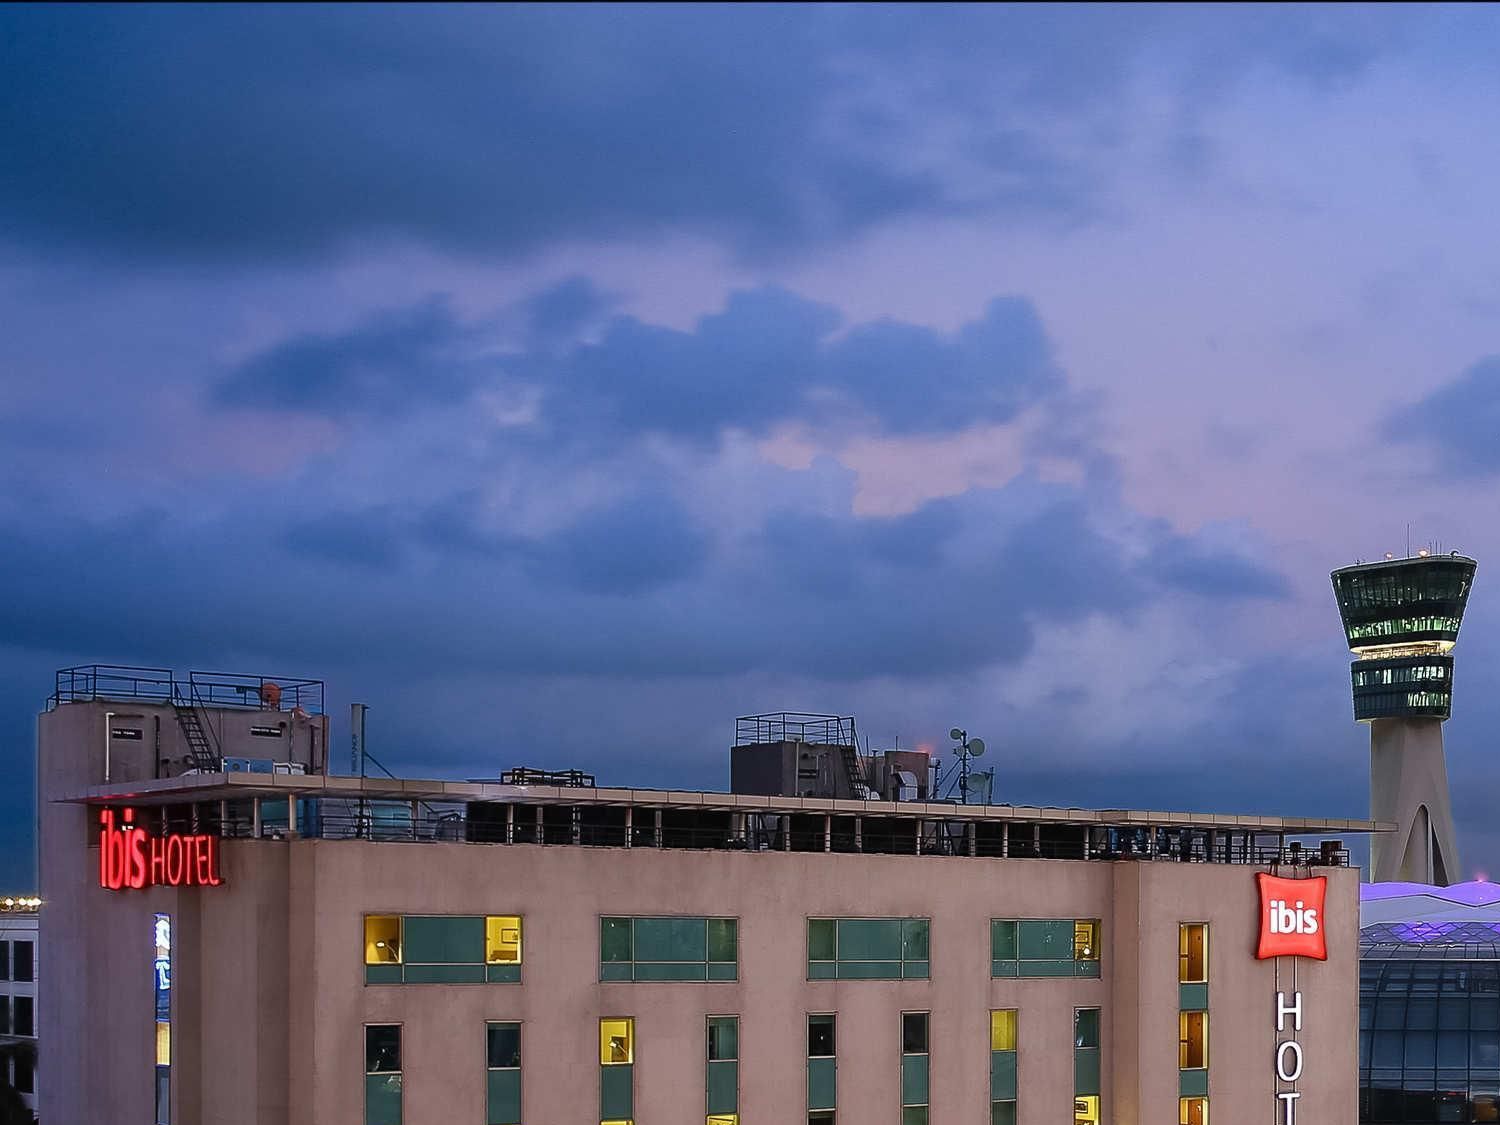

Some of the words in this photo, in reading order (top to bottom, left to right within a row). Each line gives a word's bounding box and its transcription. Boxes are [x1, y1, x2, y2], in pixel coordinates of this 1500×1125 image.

[100, 807, 146, 889] ibis
[151, 834, 219, 886] HOTEL
[1270, 900, 1318, 934] ibis
